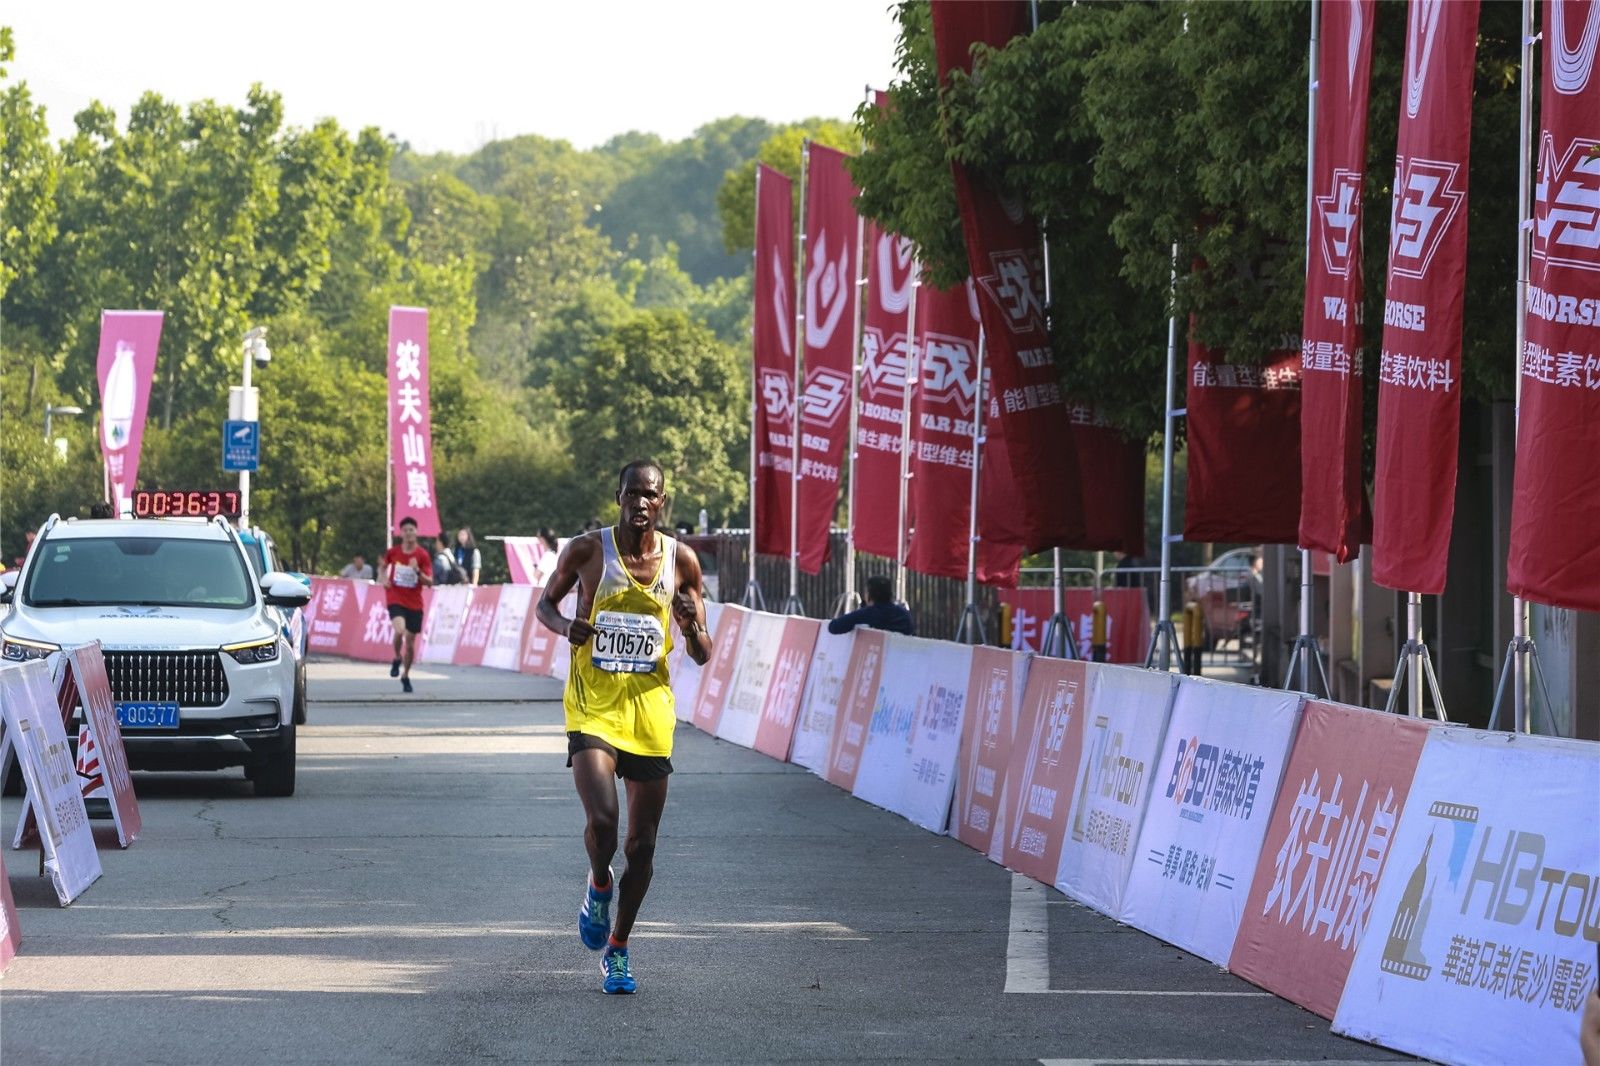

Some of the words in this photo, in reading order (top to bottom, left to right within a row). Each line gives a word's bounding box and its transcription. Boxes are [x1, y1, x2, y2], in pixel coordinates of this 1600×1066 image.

[395, 339, 432, 509] 农夫山泉
[136, 492, 237, 515] 00:36:37
[595, 630, 654, 656] C10576
[1210, 748, 1265, 820] 博森体育
[1440, 934, 1597, 1013] 華誼兄弟(長沙)電影
